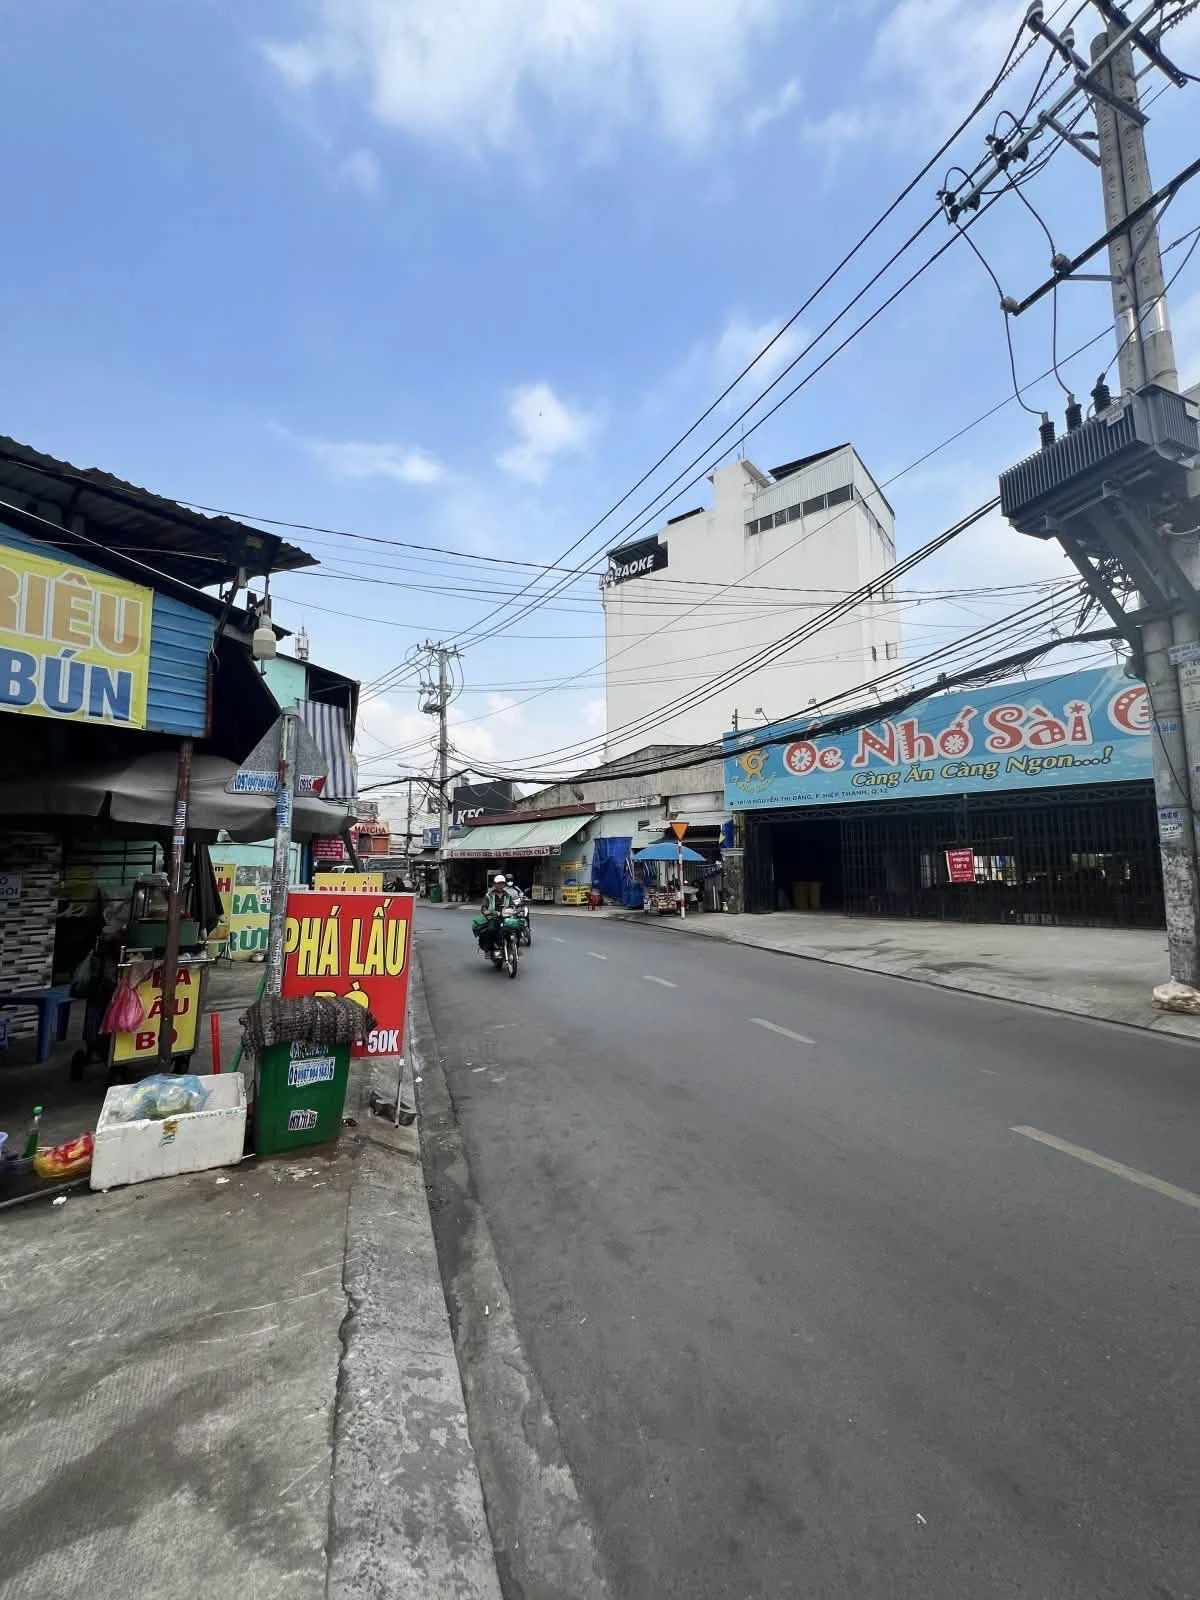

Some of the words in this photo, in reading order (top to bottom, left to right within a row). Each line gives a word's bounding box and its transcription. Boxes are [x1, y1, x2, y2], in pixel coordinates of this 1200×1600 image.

[851, 771, 900, 788] Càng
[904, 763, 935, 783] Ăn
[940, 761, 1000, 779] Càng
[283, 905, 341, 977] PHÁ
[348, 898, 408, 977] LẤU
[367, 1029, 400, 1053] 50K
